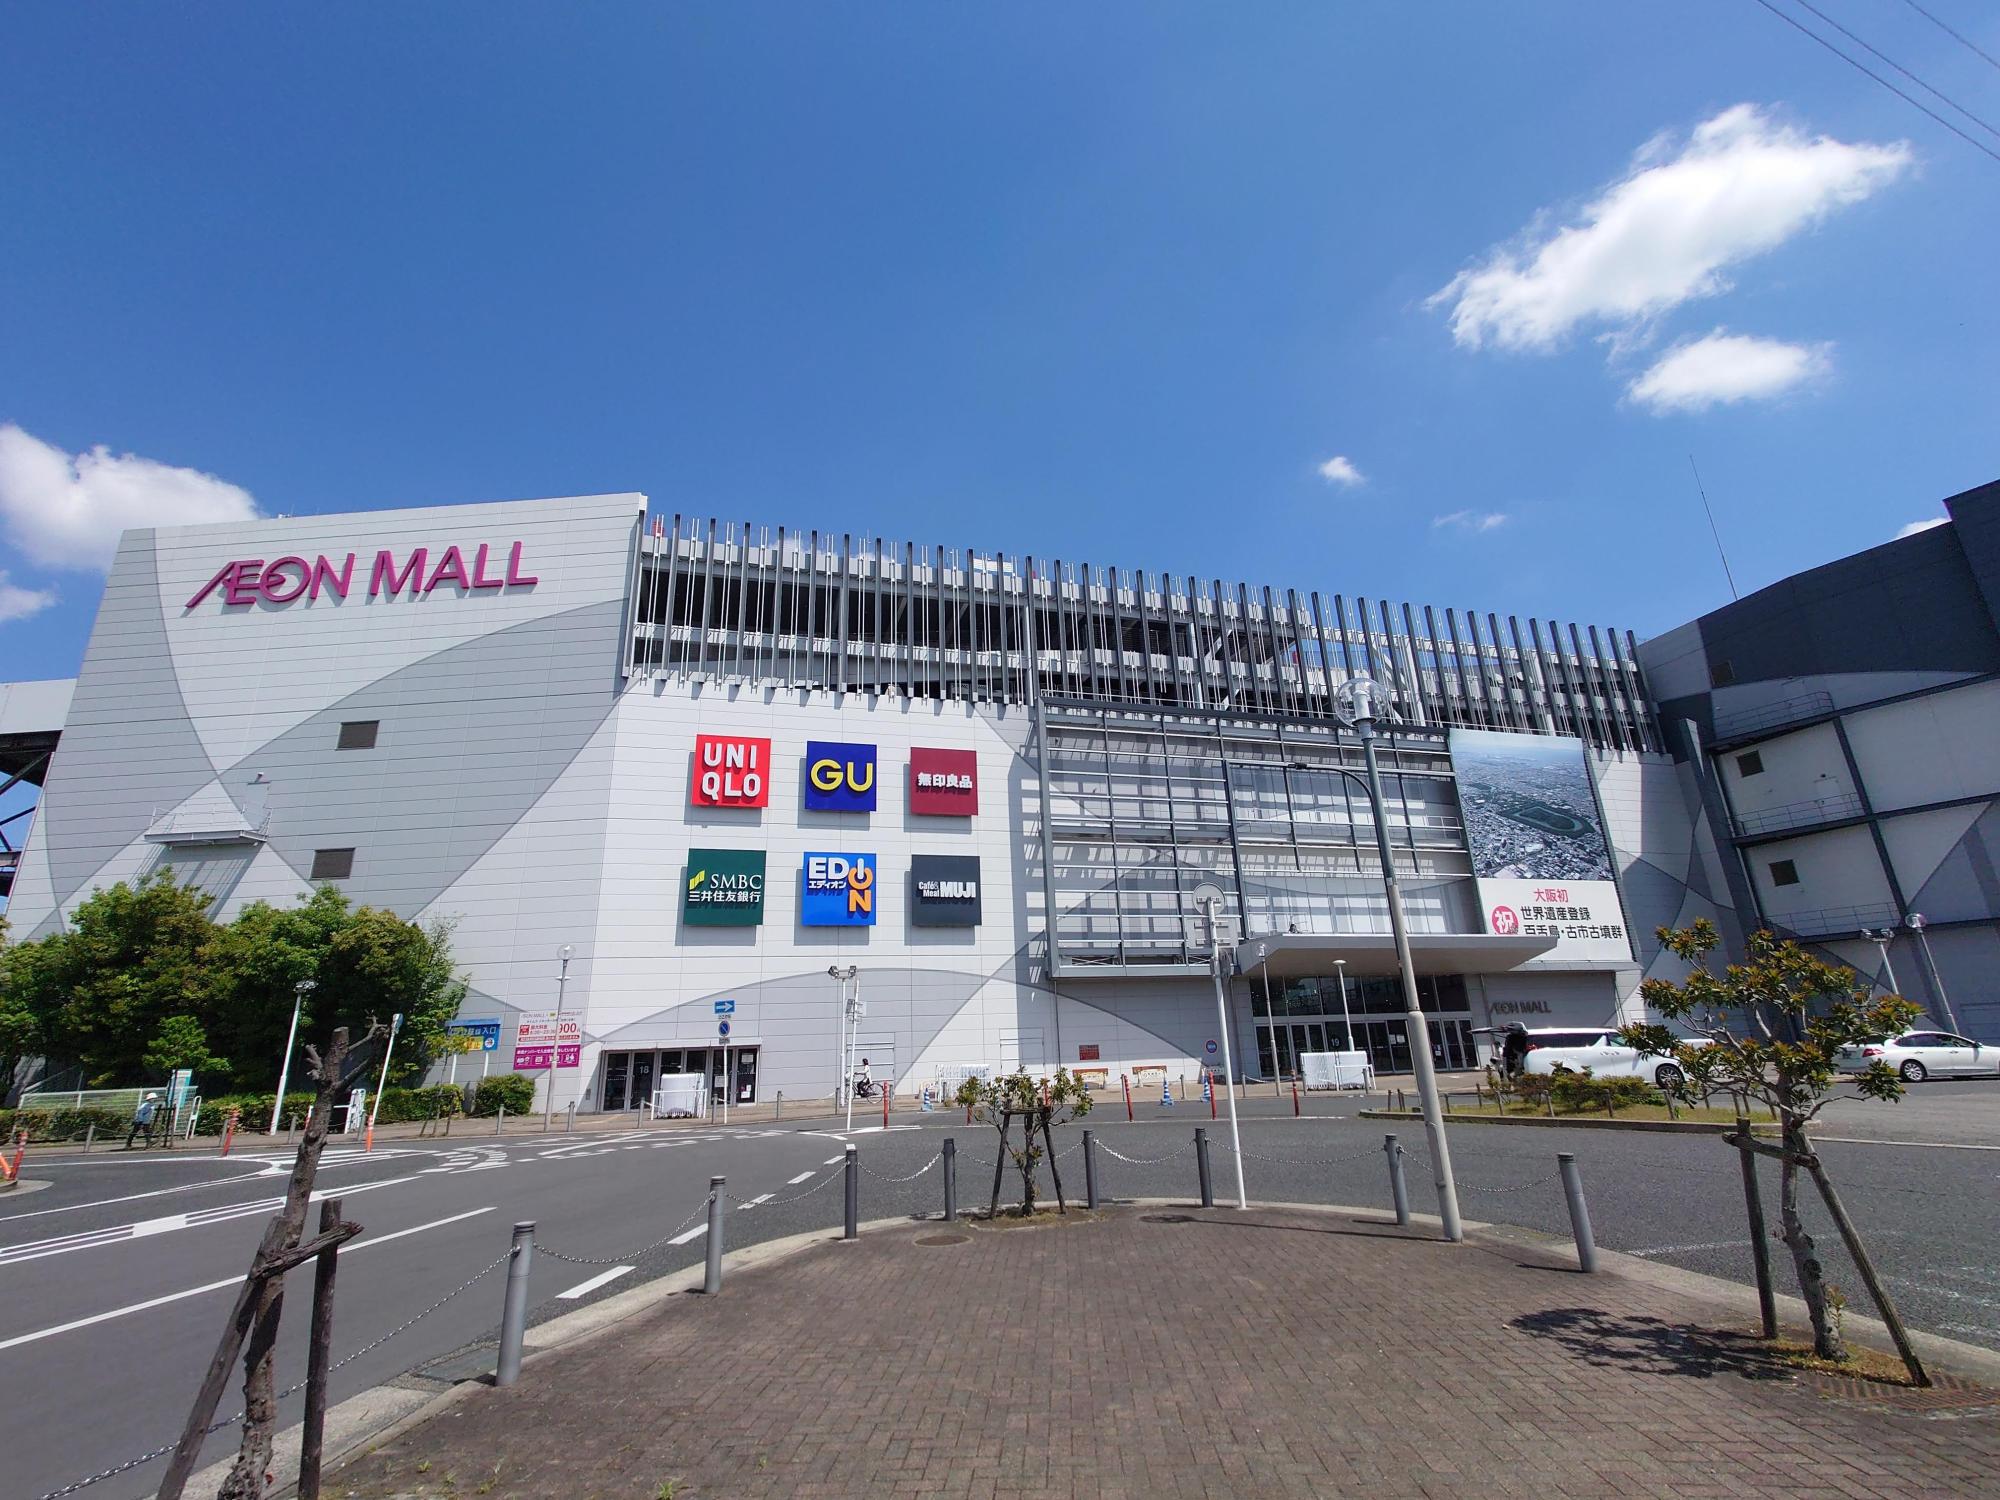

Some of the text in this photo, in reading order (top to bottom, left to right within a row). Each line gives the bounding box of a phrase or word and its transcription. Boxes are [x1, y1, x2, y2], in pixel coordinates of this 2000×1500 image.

[369, 540, 538, 596] MALL
[704, 742, 757, 769] UNI
[810, 759, 873, 792] GU
[917, 772, 972, 789] 無印良品
[701, 772, 761, 800] QLO
[711, 873, 762, 889] SMBC
[808, 880, 846, 890] エディオン
[688, 890, 760, 903] 三井住友銀行
[940, 881, 976, 898] MUJI
[1534, 888, 1569, 903] 大阪初
[1520, 906, 1591, 921] 世界遺産登録
[1331, 1038, 1340, 1047] 19
[639, 1066, 649, 1074] 18
